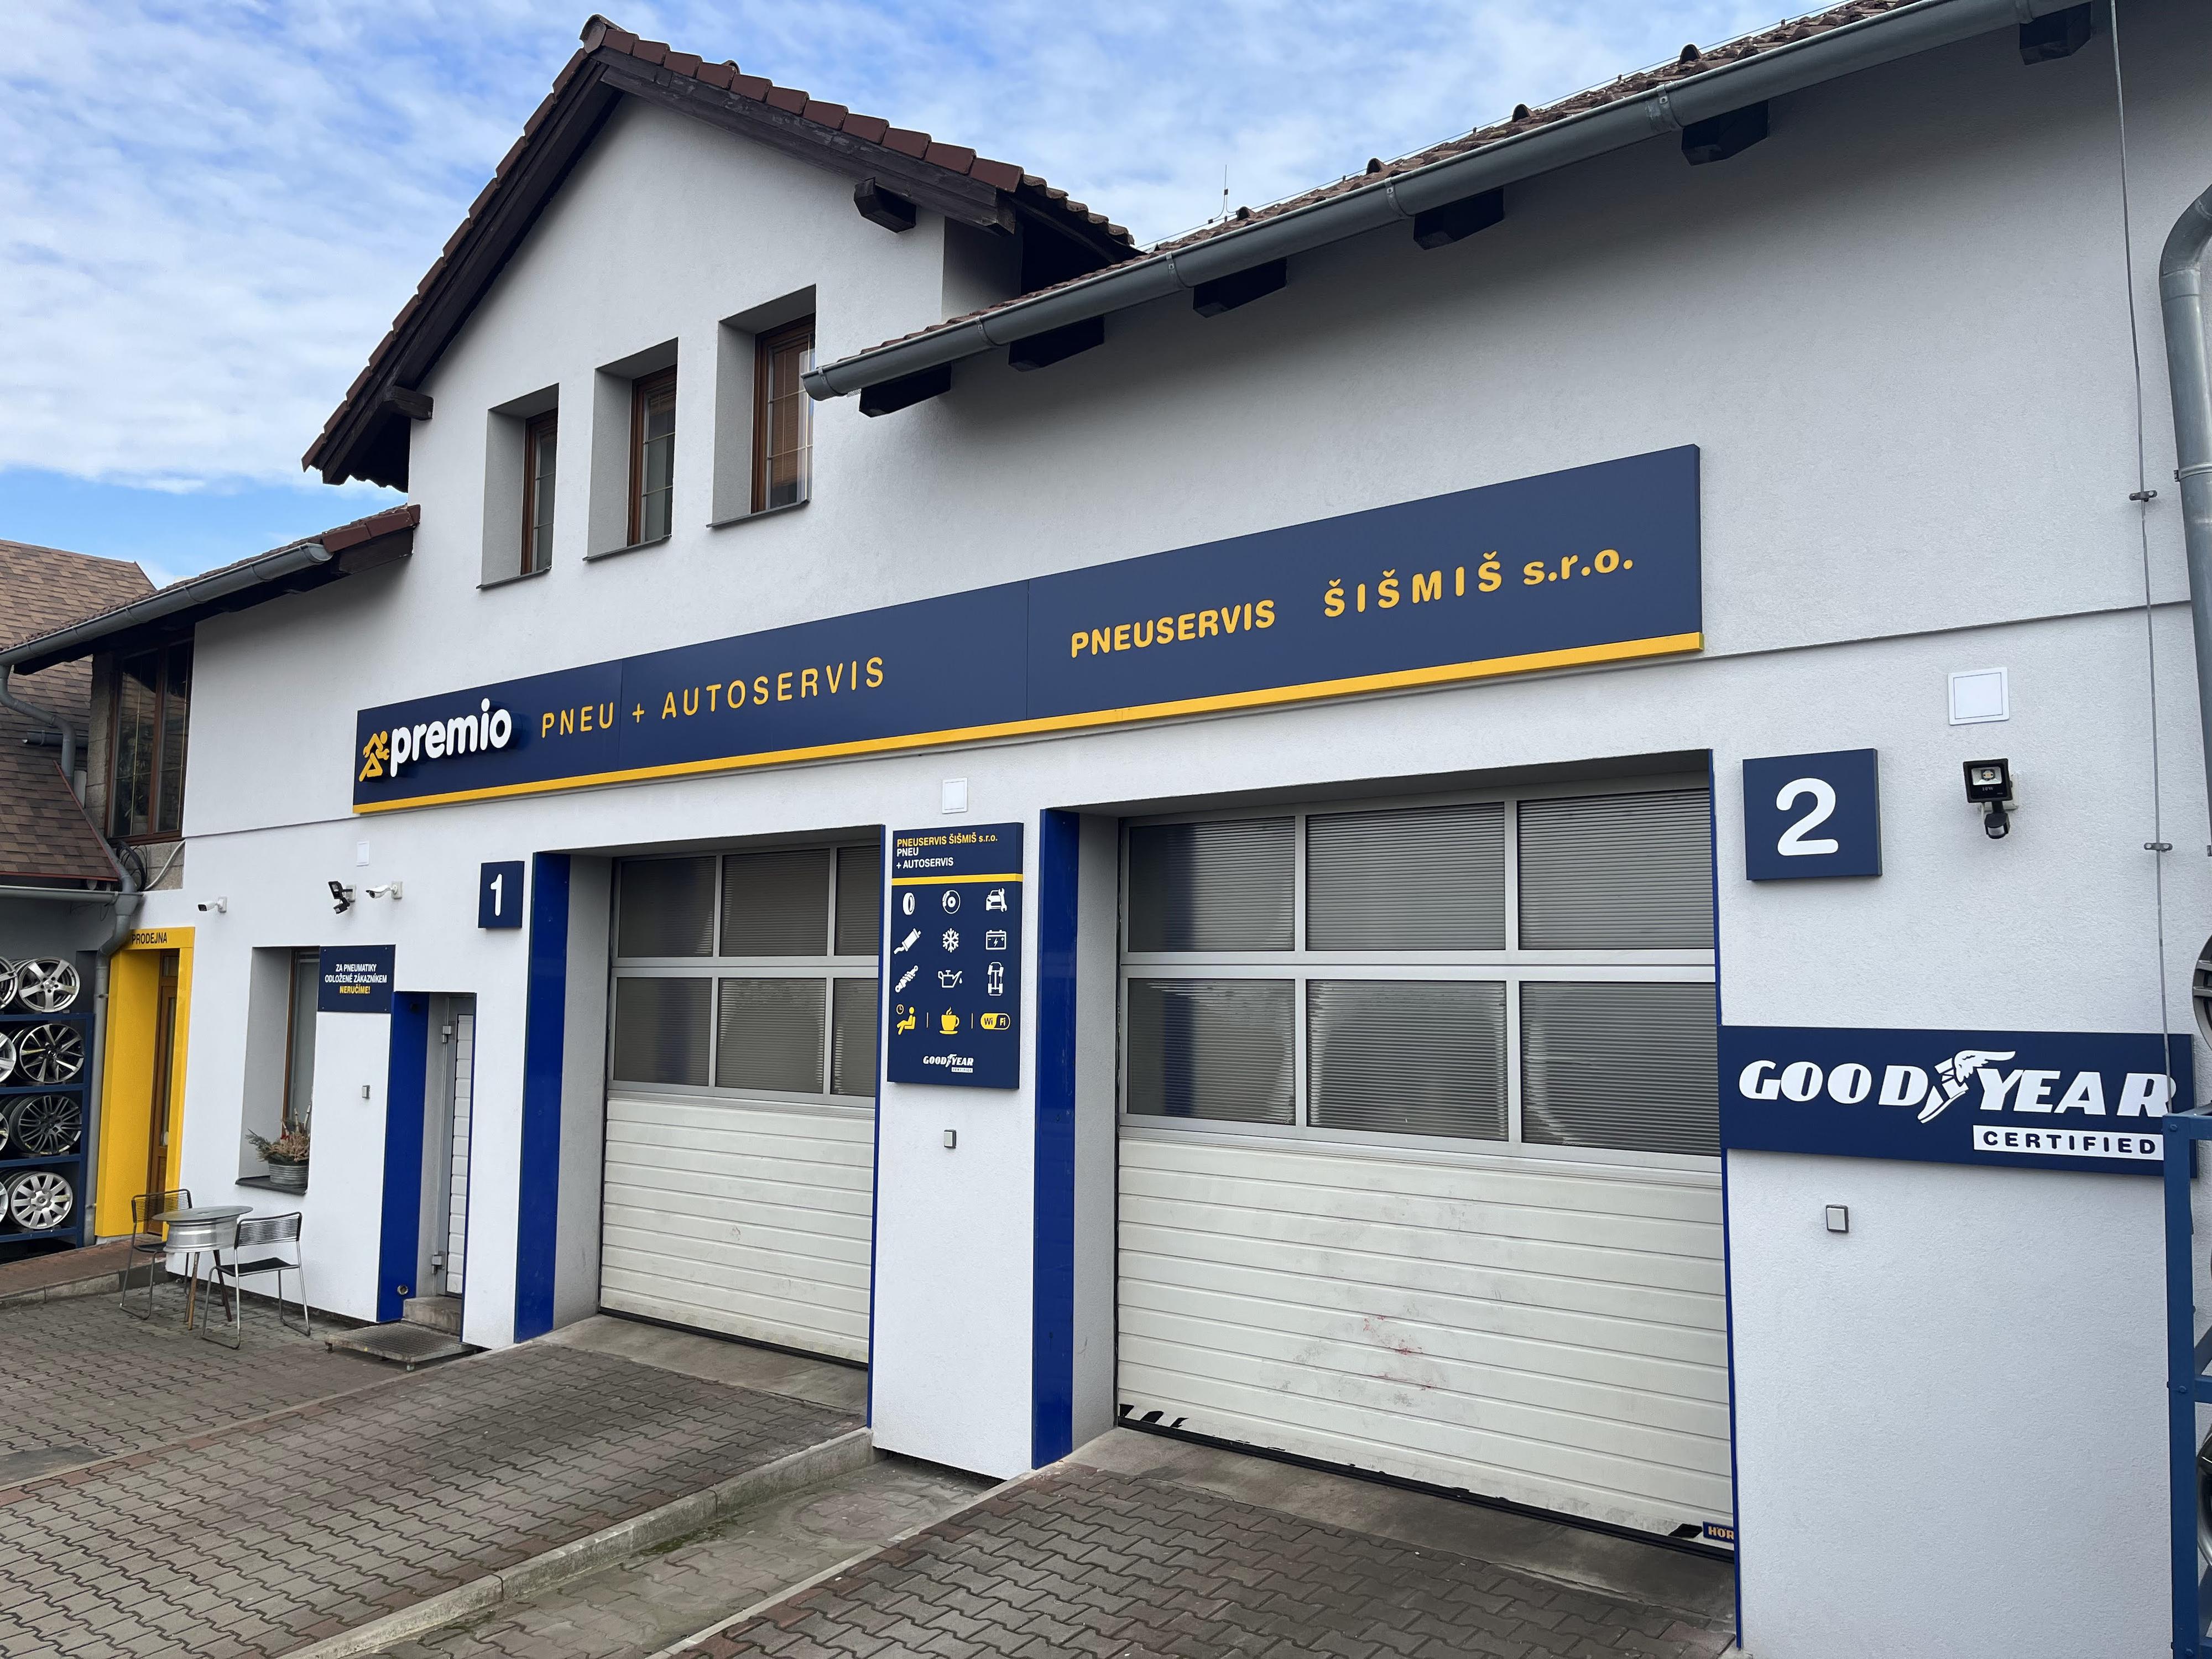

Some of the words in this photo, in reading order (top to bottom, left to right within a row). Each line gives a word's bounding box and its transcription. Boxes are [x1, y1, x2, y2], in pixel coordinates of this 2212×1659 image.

[1071, 599, 1275, 658] PNEUSERVIS
[1324, 551, 1502, 617] ŠIŠMIŠ
[1524, 549, 1633, 585] s.r.o.
[542, 702, 614, 738] PNEU
[632, 703, 645, 723] +
[661, 656, 883, 719] AUTOSERVIS
[390, 698, 512, 778] premio
[1776, 778, 1839, 856] 2
[897, 836, 947, 847] PNEUSERVIS
[948, 832, 977, 844] ŠIŠMIŠ
[978, 834, 998, 843] s.r.o.
[896, 847, 919, 857] PNEU
[902, 857, 954, 869] AUTOSERVIS
[490, 873, 503, 916] 1
[132, 932, 168, 945] PRODEJNA
[335, 964, 343, 972] ZA
[343, 963, 377, 972] PNEUMATIKY
[325, 973, 353, 983] ODLOŽENÉ
[353, 973, 387, 983] ZÁKAZNÍKEM
[339, 984, 371, 994] NERUČÍME!
[923, 1056, 974, 1066] GOODYEAR
[1739, 1060, 2177, 1118] GOODYEAR
[1983, 1130, 2156, 1155] CERTIFIED
